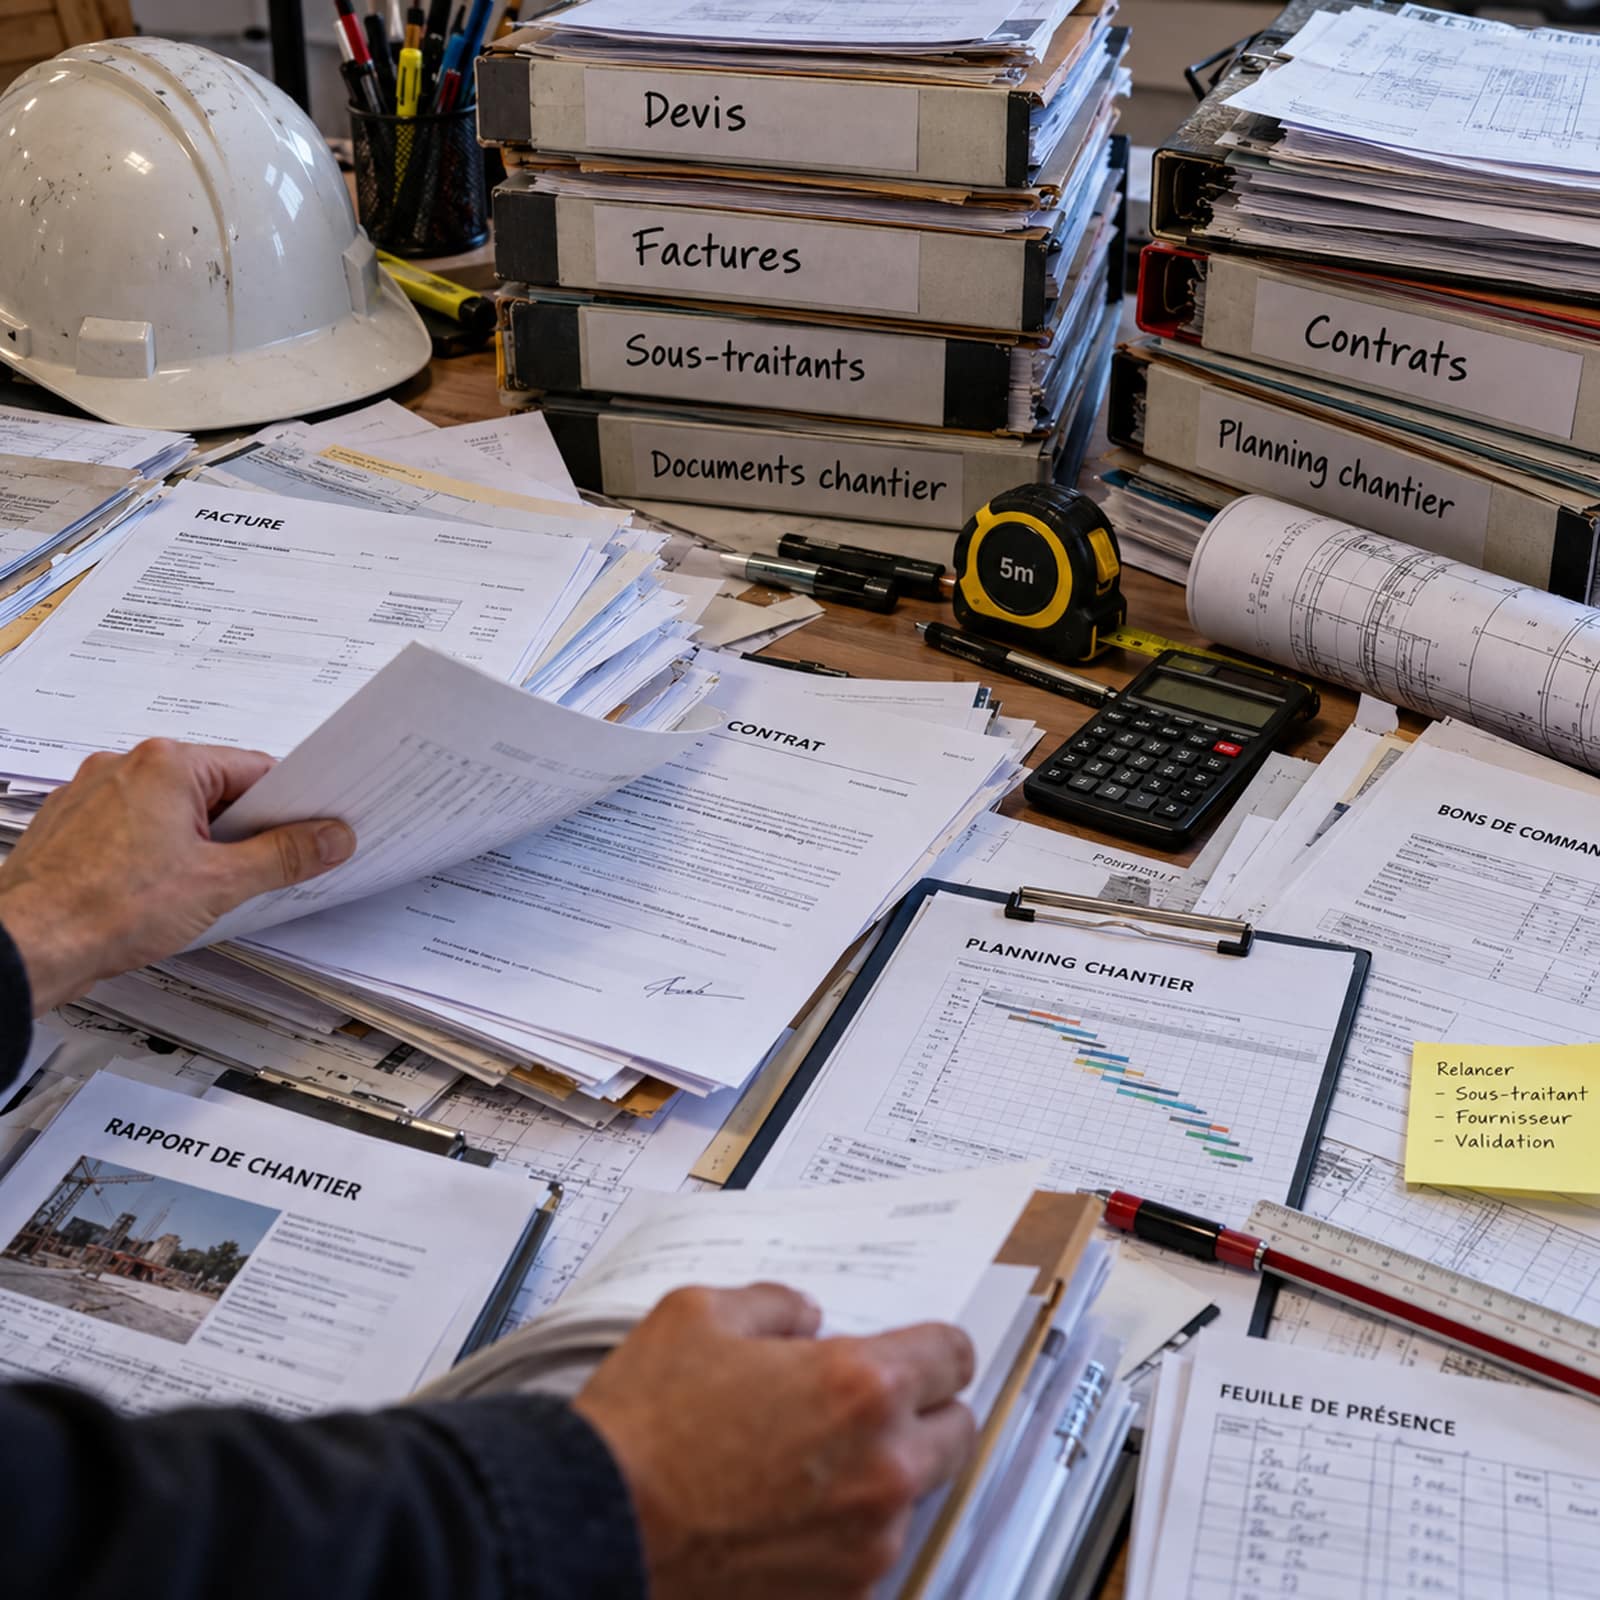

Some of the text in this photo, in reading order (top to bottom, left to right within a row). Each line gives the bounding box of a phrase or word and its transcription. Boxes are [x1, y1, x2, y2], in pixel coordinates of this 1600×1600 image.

[644, 90, 746, 132] Devis
[632, 226, 801, 274] Factures
[626, 334, 866, 382] Sous-traitants
[1305, 315, 1468, 383] Contrats
[650, 449, 947, 501] Documents chantier
[1218, 419, 1456, 518] Planning chantier
[195, 509, 285, 531] FACTURE
[999, 557, 1034, 585] 5m
[727, 721, 826, 752] CONTRAT
[1438, 804, 1486, 826] BONS
[1491, 818, 1517, 834] DE
[965, 938, 1077, 969] PLANNING
[1084, 961, 1194, 993] CHANTIER
[1437, 1061, 1514, 1077] Relancer
[1455, 1085, 1588, 1101] Sous-traitant
[1457, 1109, 1572, 1125] Fournisseur
[103, 1117, 362, 1201] RAPPORT DE CHANTIER
[1455, 1133, 1555, 1149] Validation
[1220, 1383, 1455, 1436] FEUILLE DE PRÉSENCE
